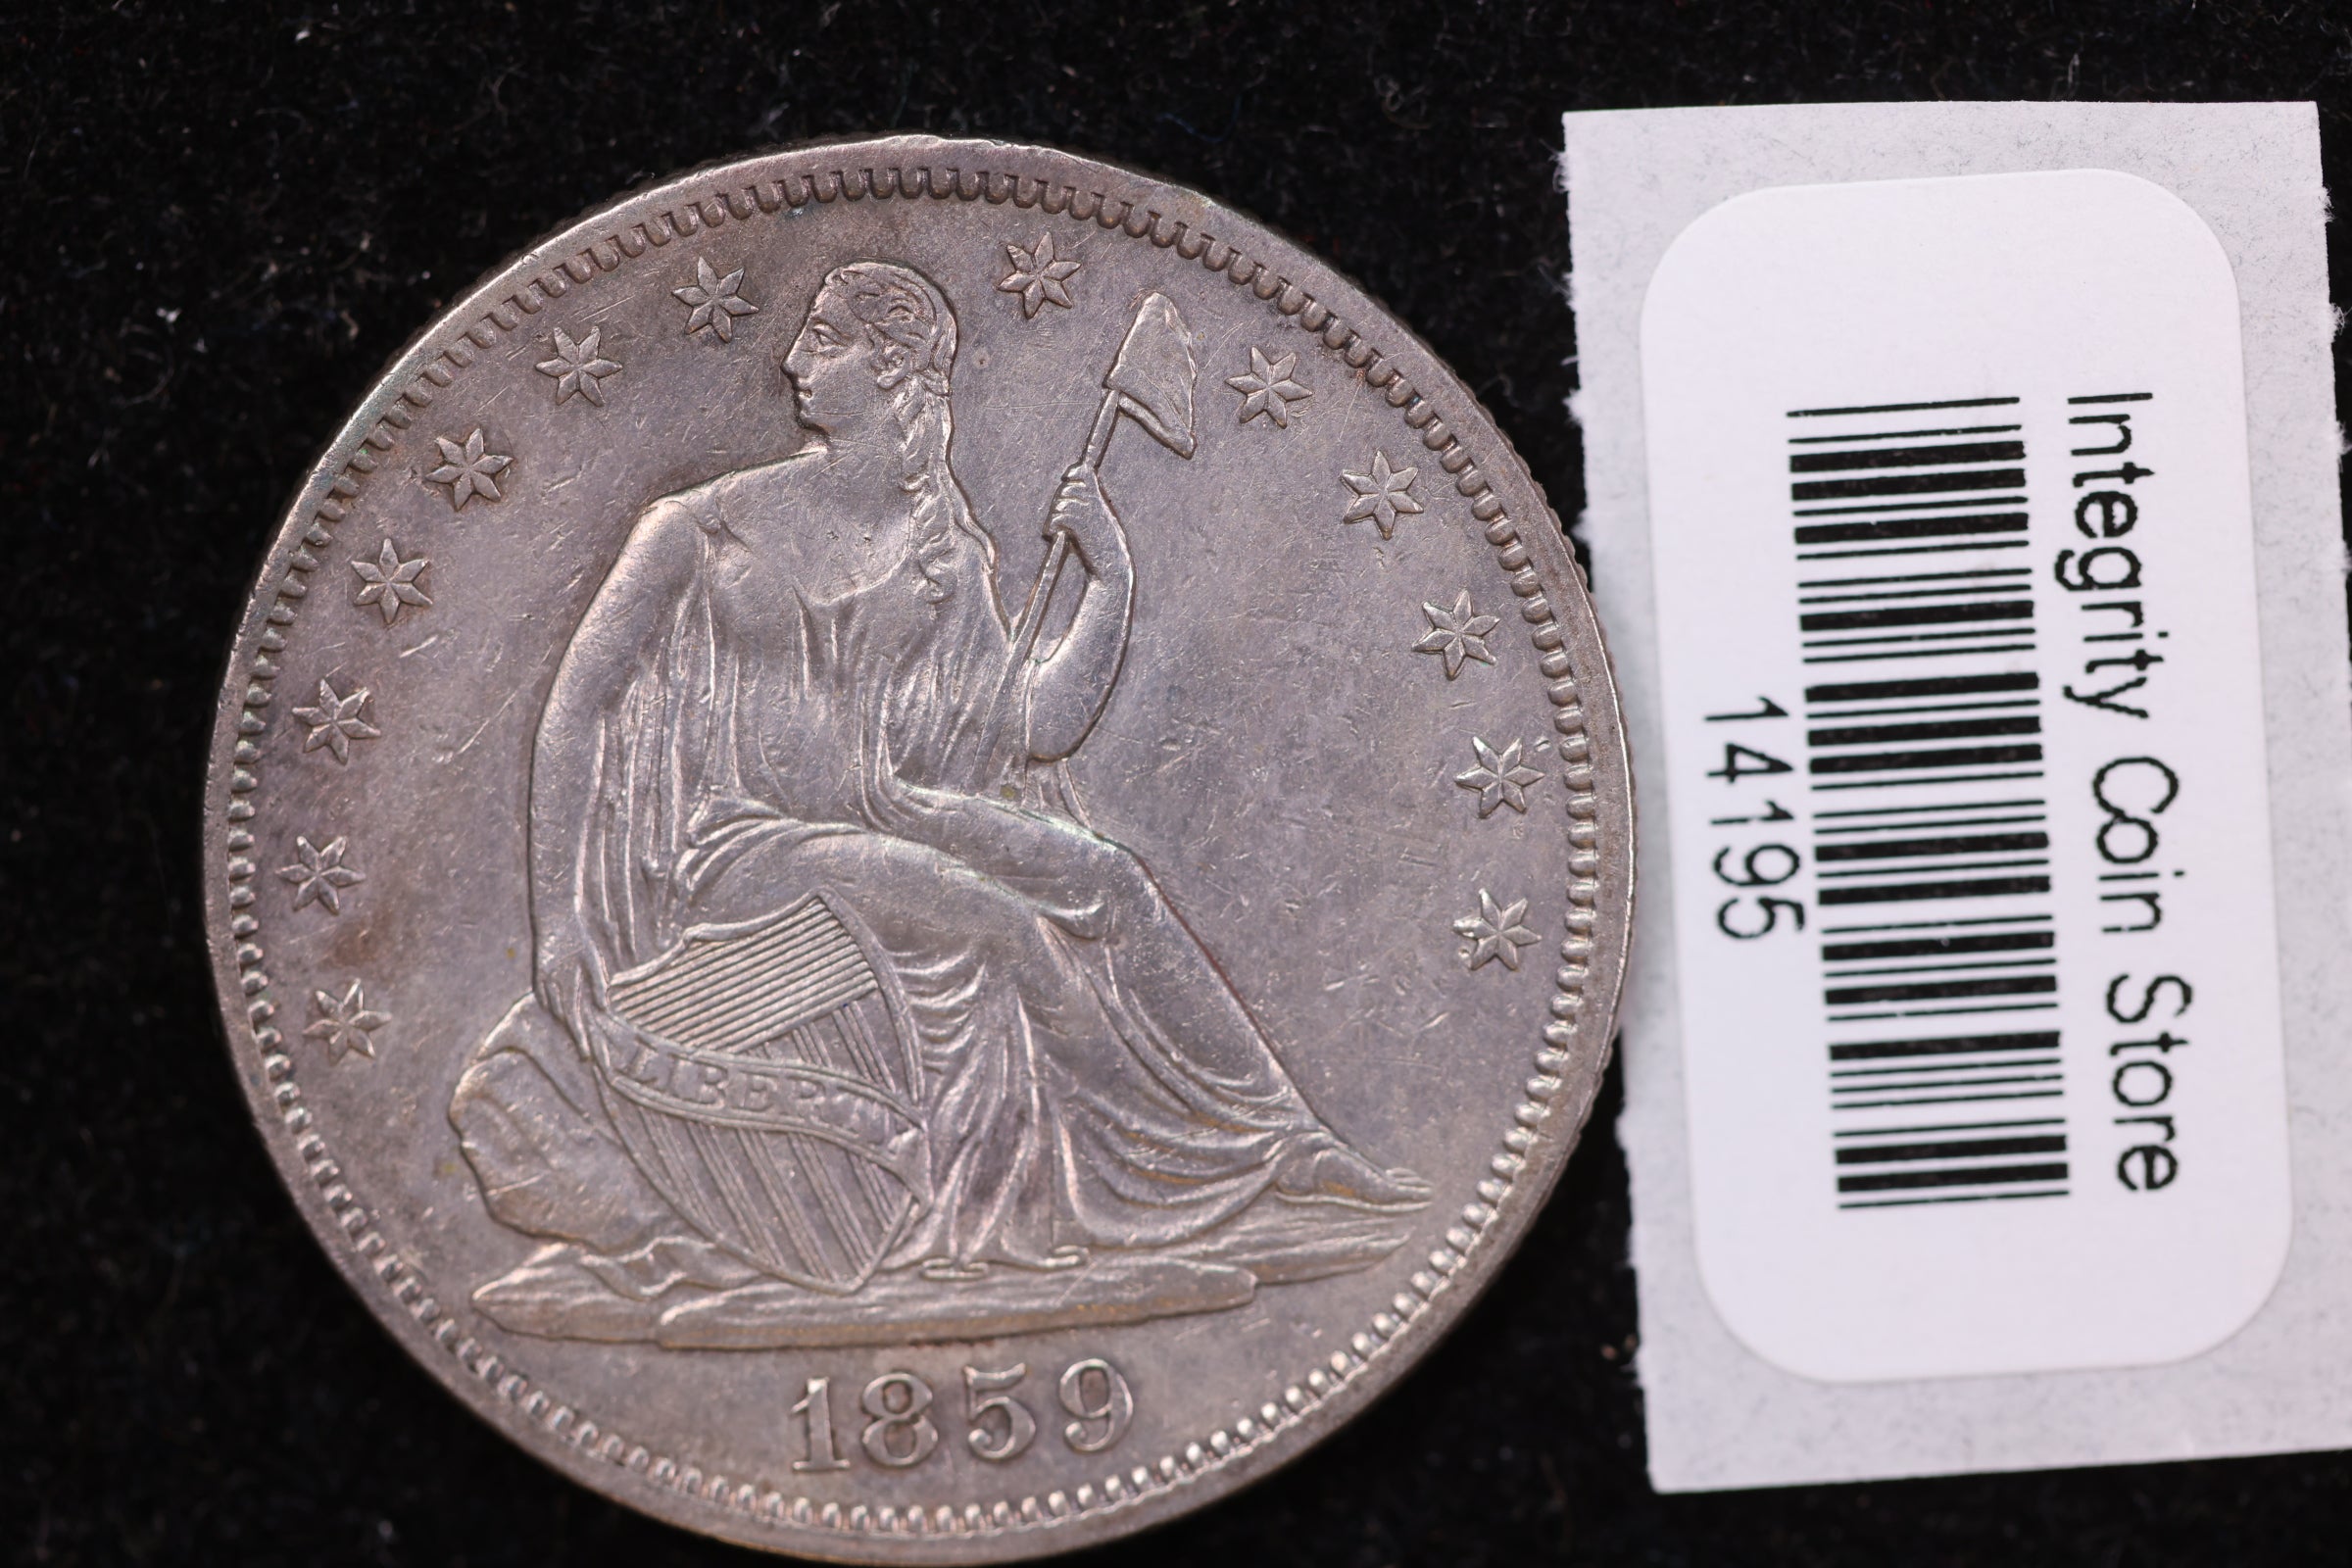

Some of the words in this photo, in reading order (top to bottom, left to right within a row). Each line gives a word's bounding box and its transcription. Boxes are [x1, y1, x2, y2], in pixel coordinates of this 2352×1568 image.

[2053, 391, 2169, 719] Integrity
[1705, 696, 1805, 939] 14195
[2091, 756, 2184, 933] Coin
[2105, 973, 2193, 1192] Store
[790, 1357, 1134, 1472] 1859
